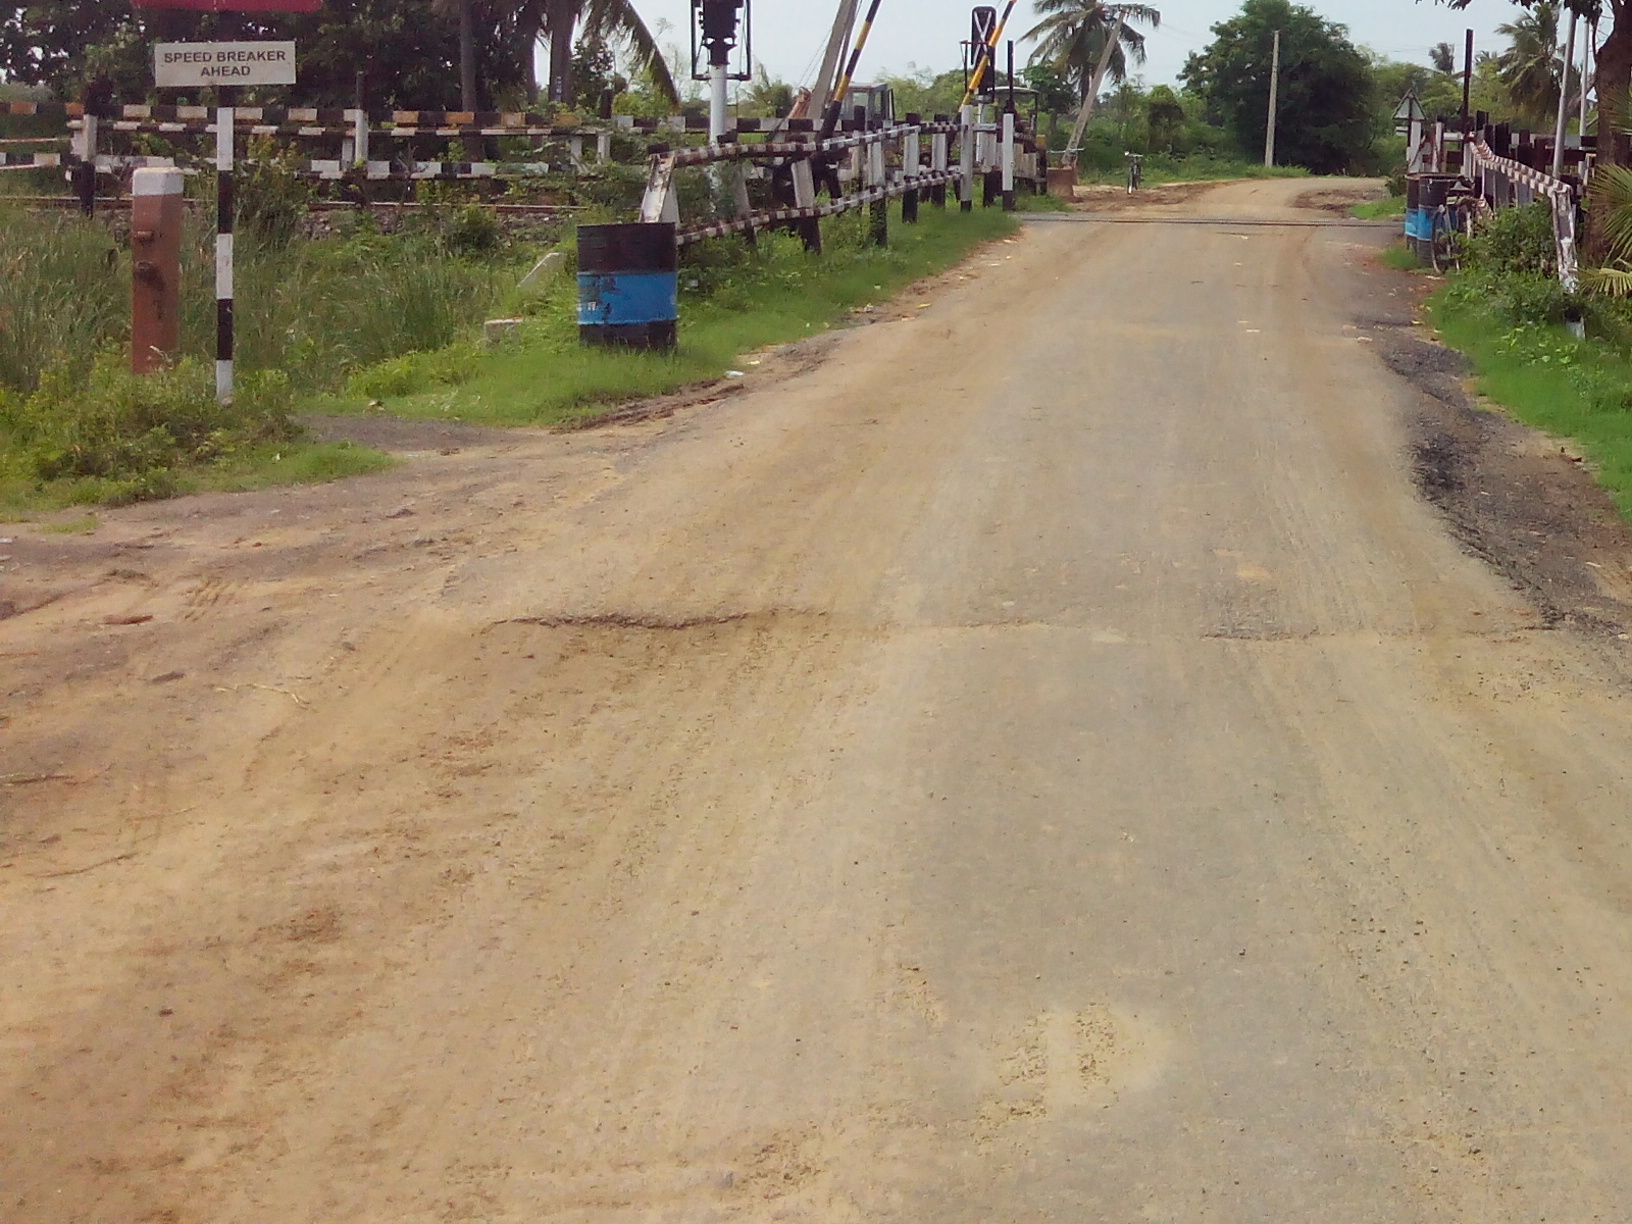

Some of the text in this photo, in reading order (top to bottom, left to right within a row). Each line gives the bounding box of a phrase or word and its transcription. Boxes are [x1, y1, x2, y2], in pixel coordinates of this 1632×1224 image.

[164, 50, 286, 63] SPEED BREAKER
[200, 65, 251, 77] AHEAD
